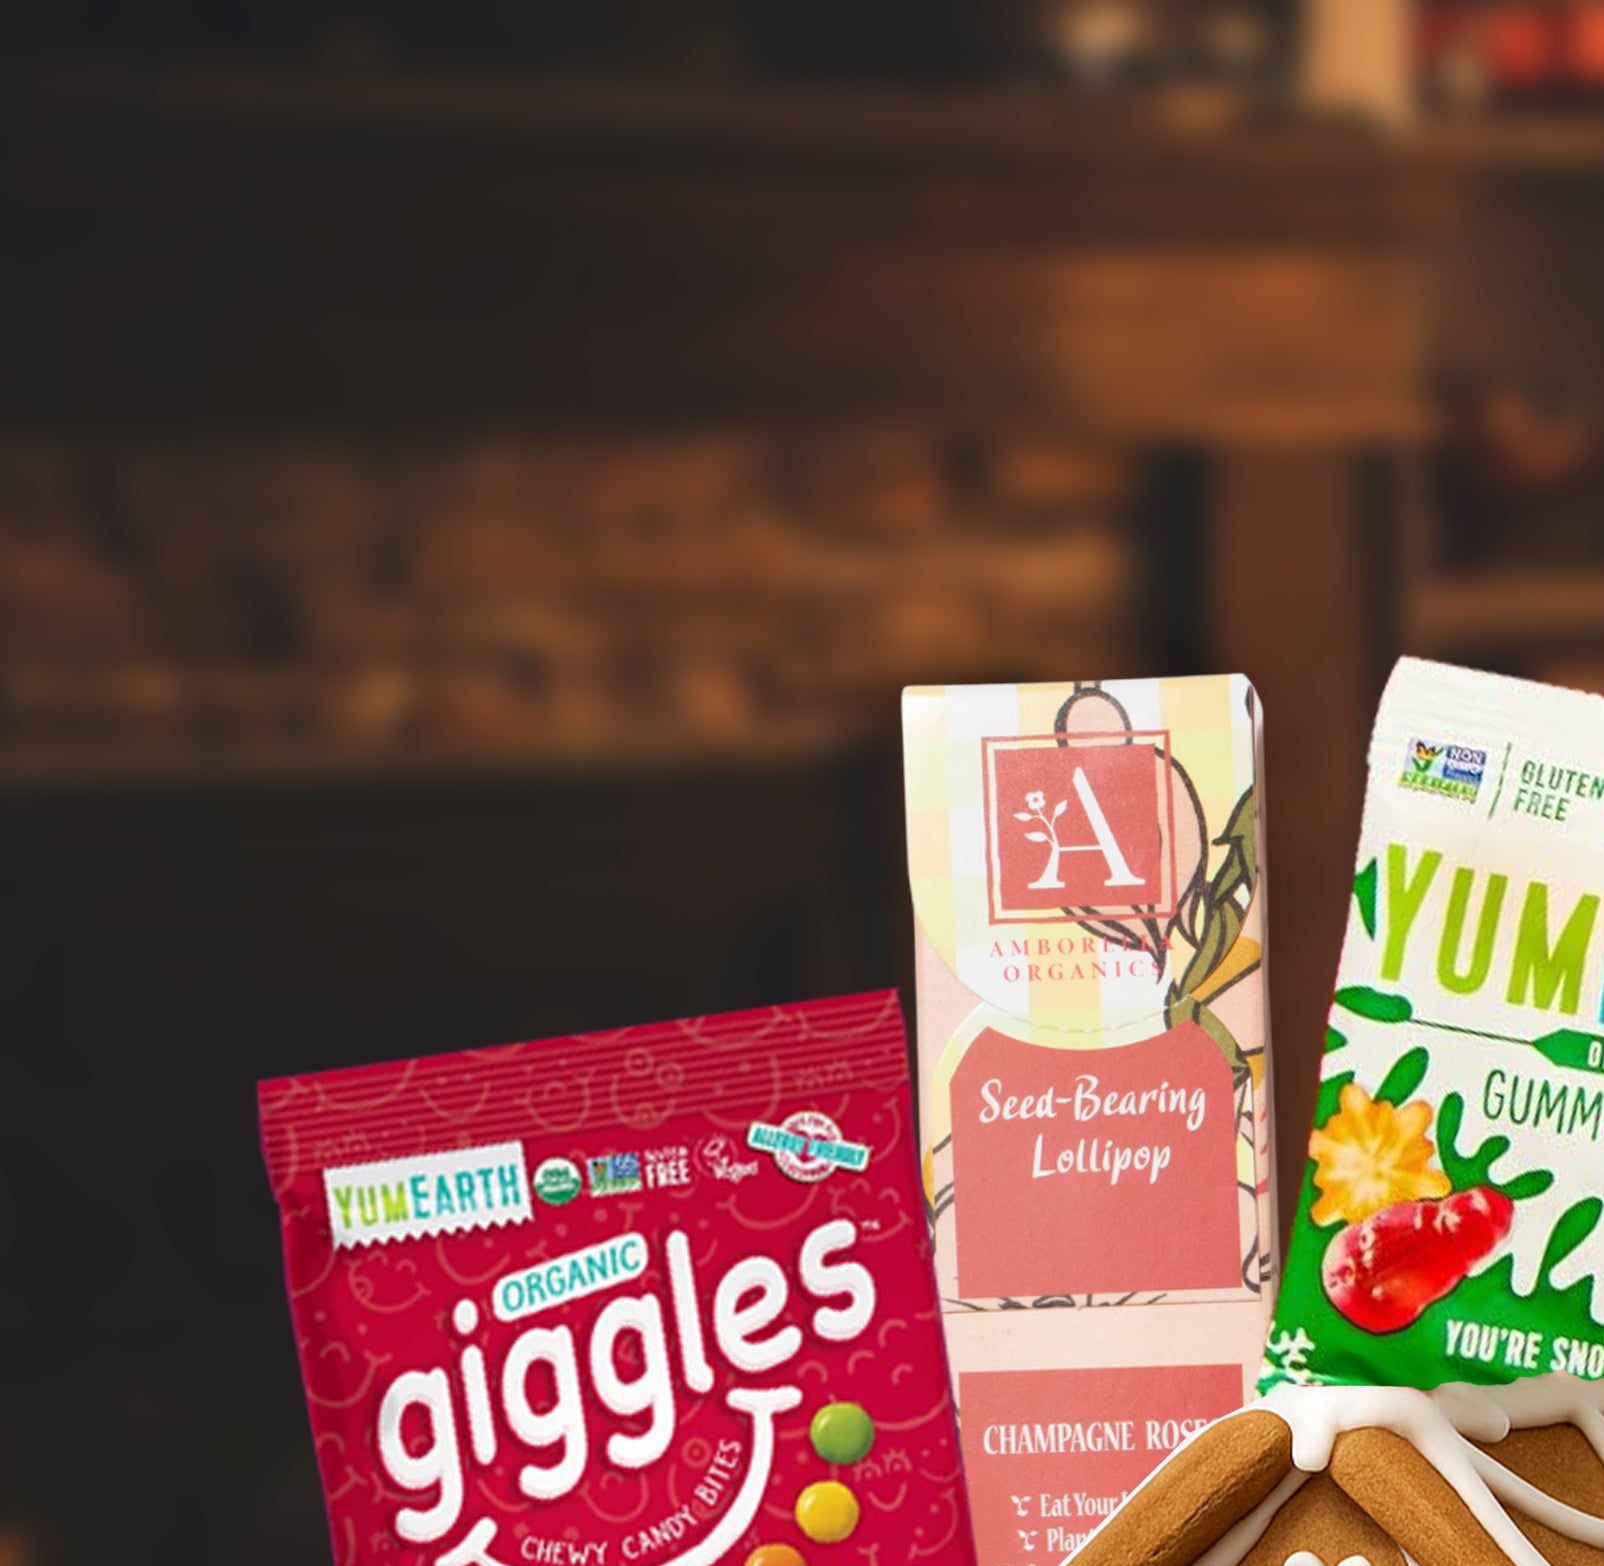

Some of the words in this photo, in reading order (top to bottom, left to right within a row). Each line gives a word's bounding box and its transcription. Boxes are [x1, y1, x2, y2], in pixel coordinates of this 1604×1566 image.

[1513, 788, 1571, 822] FREE
[1003, 959, 1163, 983] ORGANICS
[979, 1074, 1206, 1131] Seed-Bearing
[645, 1158, 691, 1189] FREE
[1032, 1133, 1171, 1186] Lollipop
[333, 1164, 521, 1230] YUMEARTH
[502, 1240, 642, 1314] ORGANIC
[1446, 1319, 1543, 1369] YOU'RE
[378, 1218, 876, 1543] giggles
[983, 1421, 1135, 1455] CHAMPAGNE
[521, 1535, 608, 1566] CHEWY
[621, 1503, 698, 1560] CANDY
[693, 1437, 742, 1506] BITES
[1040, 1493, 1071, 1517] Eat
[1073, 1492, 1118, 1516] Your
